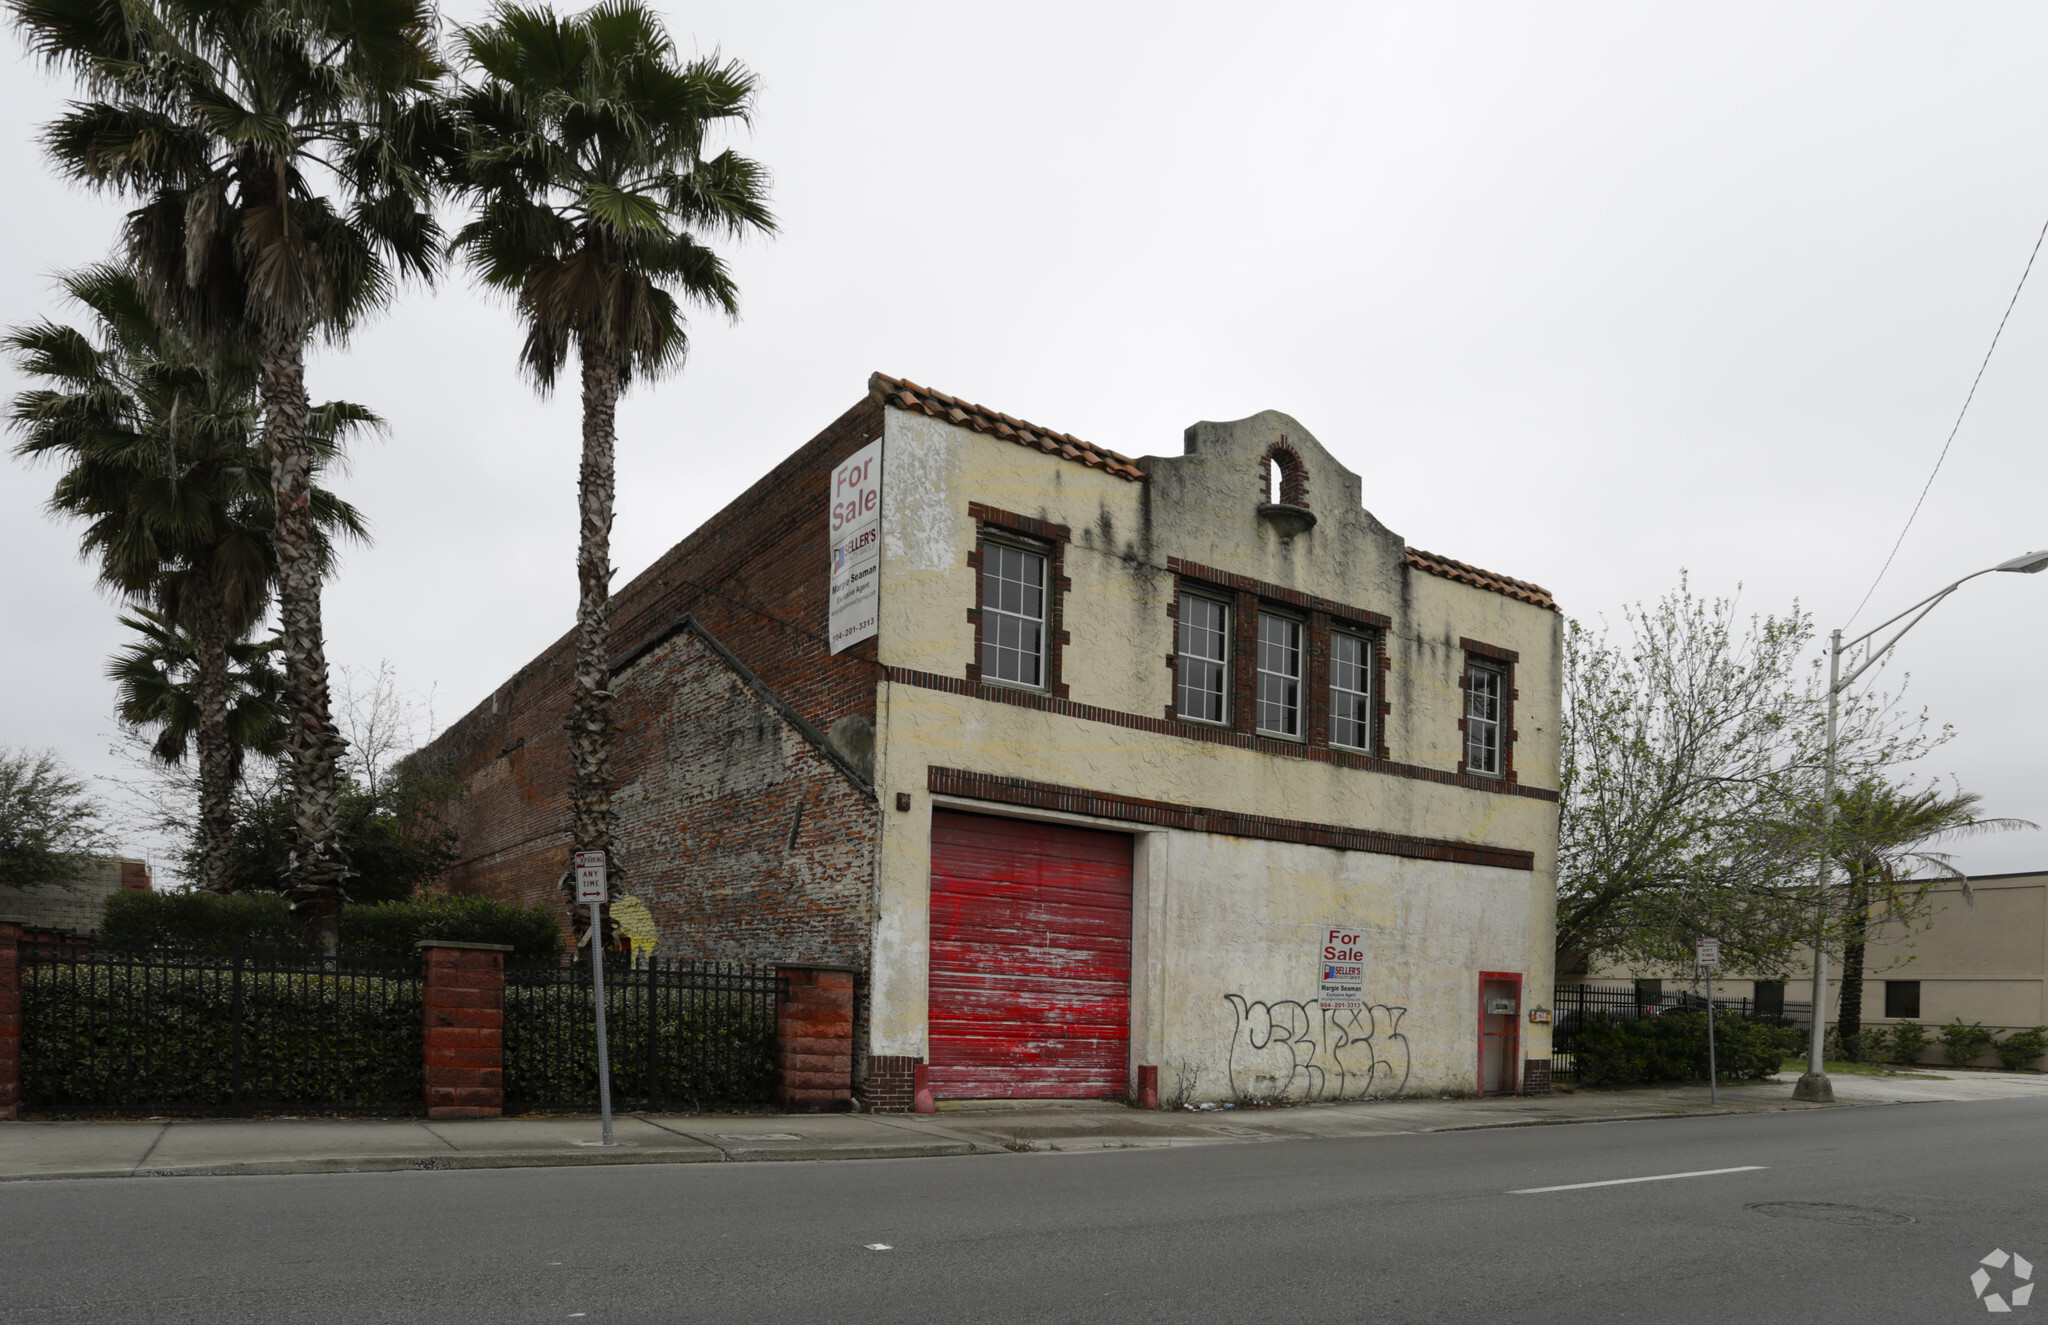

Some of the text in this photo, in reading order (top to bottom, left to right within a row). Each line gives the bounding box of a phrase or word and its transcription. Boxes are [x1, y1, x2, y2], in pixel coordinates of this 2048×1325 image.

[837, 457, 873, 498] For
[832, 488, 877, 532] Sale
[845, 529, 876, 556] SELLER'S
[850, 565, 877, 583] Seaman
[855, 581, 871, 596] Agent
[1329, 930, 1360, 945] For
[1324, 946, 1364, 962] Sale
[1335, 966, 1361, 975] SELLER'S
[1321, 984, 1339, 992] Margie
